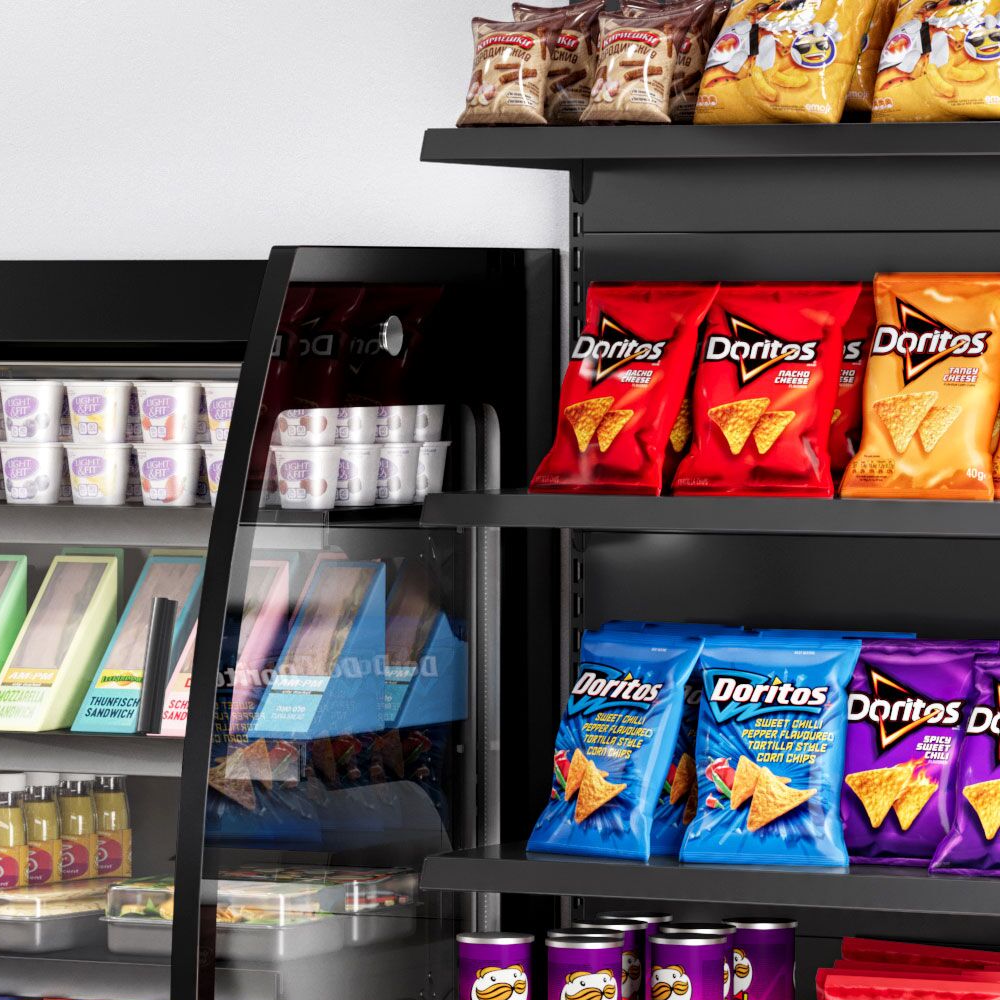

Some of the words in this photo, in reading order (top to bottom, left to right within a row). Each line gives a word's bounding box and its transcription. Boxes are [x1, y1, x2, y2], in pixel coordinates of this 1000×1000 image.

[873, 326, 989, 355] Doritos
[571, 335, 667, 361] Doritos
[706, 336, 818, 361] Doritos
[625, 369, 653, 377] NACHO
[778, 369, 811, 378] NACHO
[949, 366, 979, 375] TANGY
[620, 376, 652, 384] CHEESE
[774, 377, 810, 385] CHEESE
[943, 374, 978, 383] CHEESE
[571, 671, 663, 702] Doritos
[710, 677, 829, 706] Doritos
[89, 696, 140, 708] THUNFISCH
[84, 707, 135, 719] SANDWICH
[847, 693, 962, 725] Doritos
[594, 712, 620, 724] SWEET
[621, 713, 647, 725] CHILLI
[754, 718, 790, 728] SWEET
[791, 719, 824, 730] CHILLI
[581, 722, 609, 734] PEPPER
[608, 724, 654, 738] FLAVOURED
[741, 728, 778, 740] PEPPER
[779, 730, 835, 742] FLAVOURED
[583, 734, 616, 746] TORTILLA
[616, 737, 644, 749] STYLE
[923, 735, 952, 744] SPICY
[748, 740, 794, 751] TORTILLA
[795, 742, 827, 753] STYLE
[916, 743, 951, 752] SWEET
[586, 746, 608, 757] CORN
[607, 748, 633, 760] CHIPS
[756, 752, 784, 763] CORN
[785, 753, 816, 764] CHIPS
[924, 751, 950, 761] CHILI
